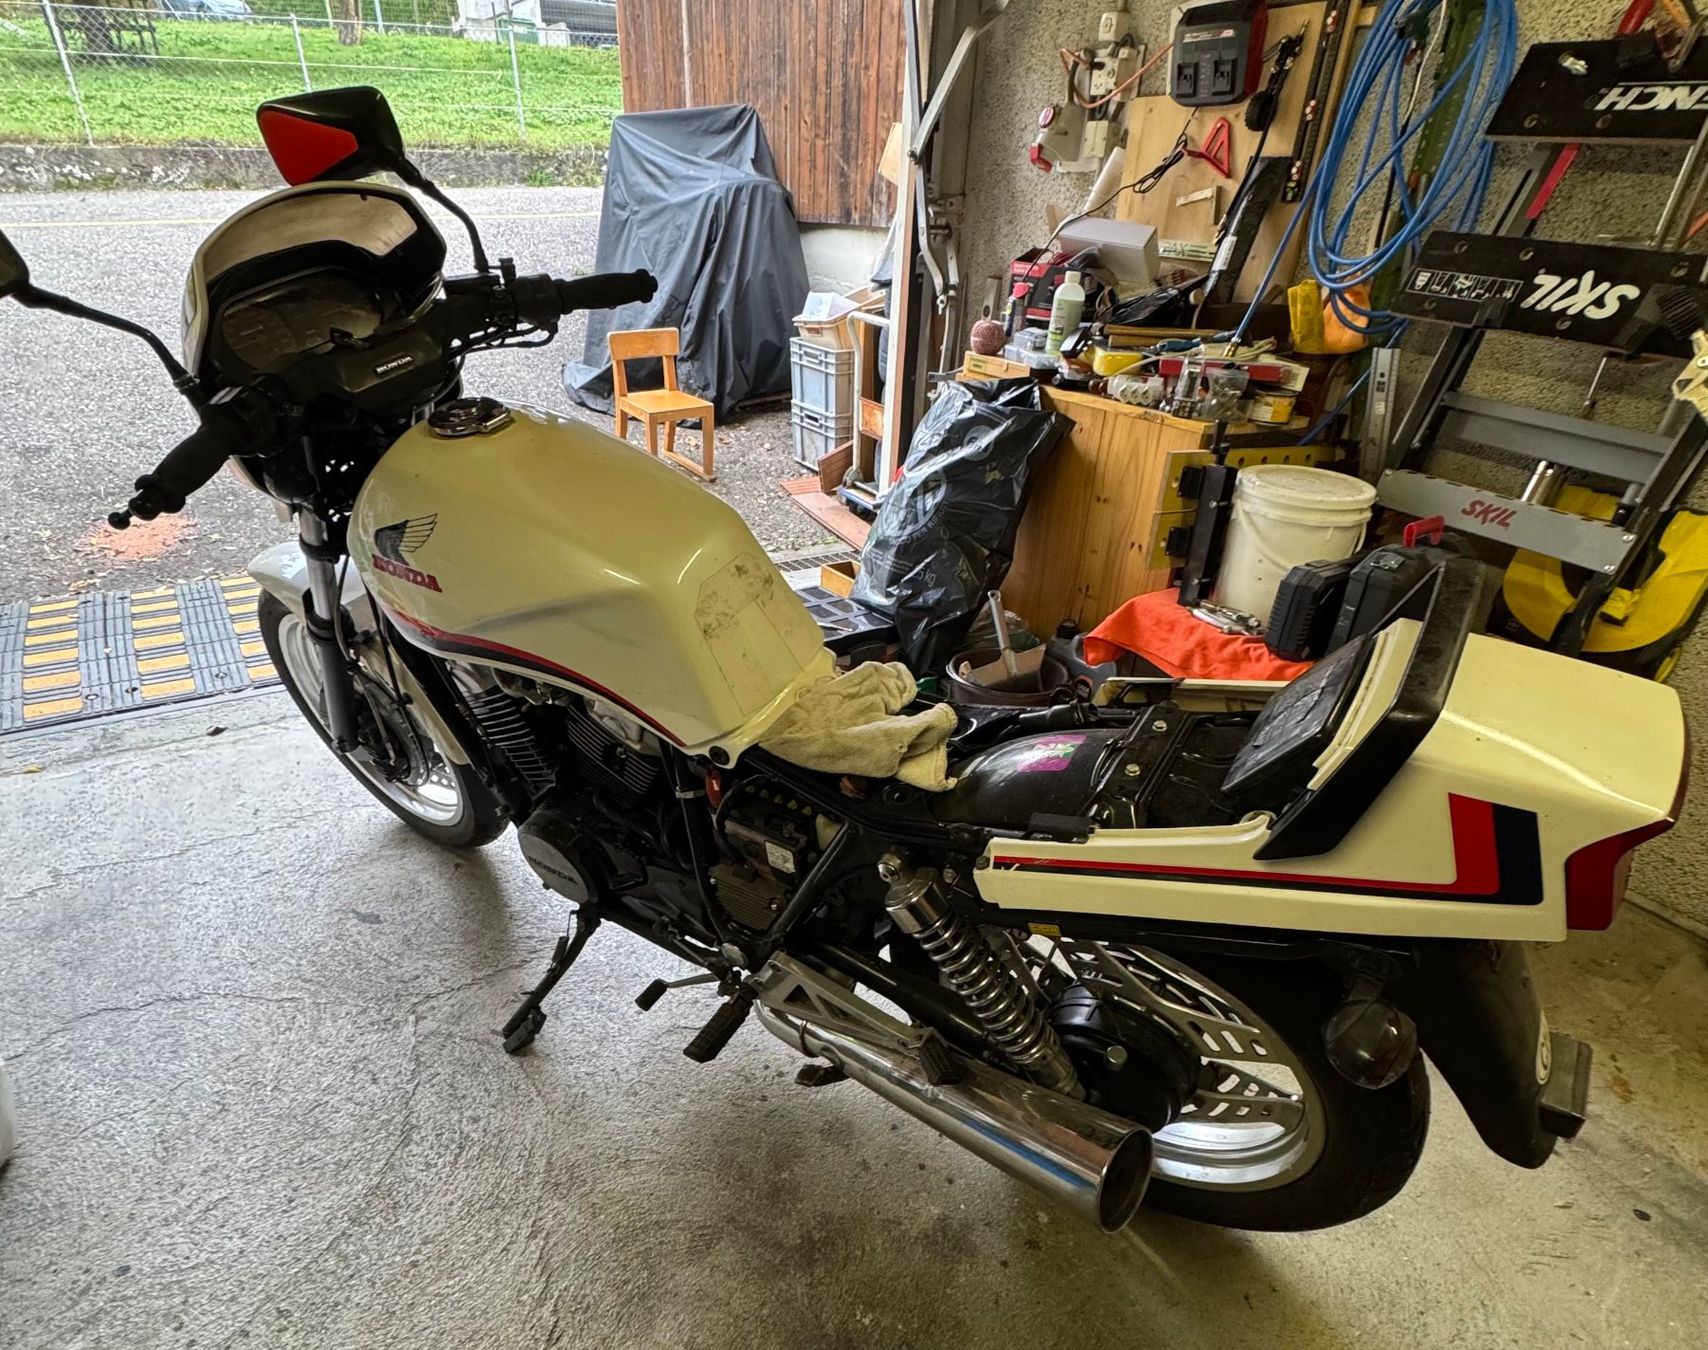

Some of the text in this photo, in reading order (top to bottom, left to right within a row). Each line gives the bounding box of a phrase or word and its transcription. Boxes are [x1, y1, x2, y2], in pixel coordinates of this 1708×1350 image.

[1520, 270, 1641, 320] SKIL
[376, 356, 414, 374] HONDA
[1461, 499, 1518, 528] SKIL
[371, 553, 443, 593] HONDA
[528, 855, 578, 885] HONDA
